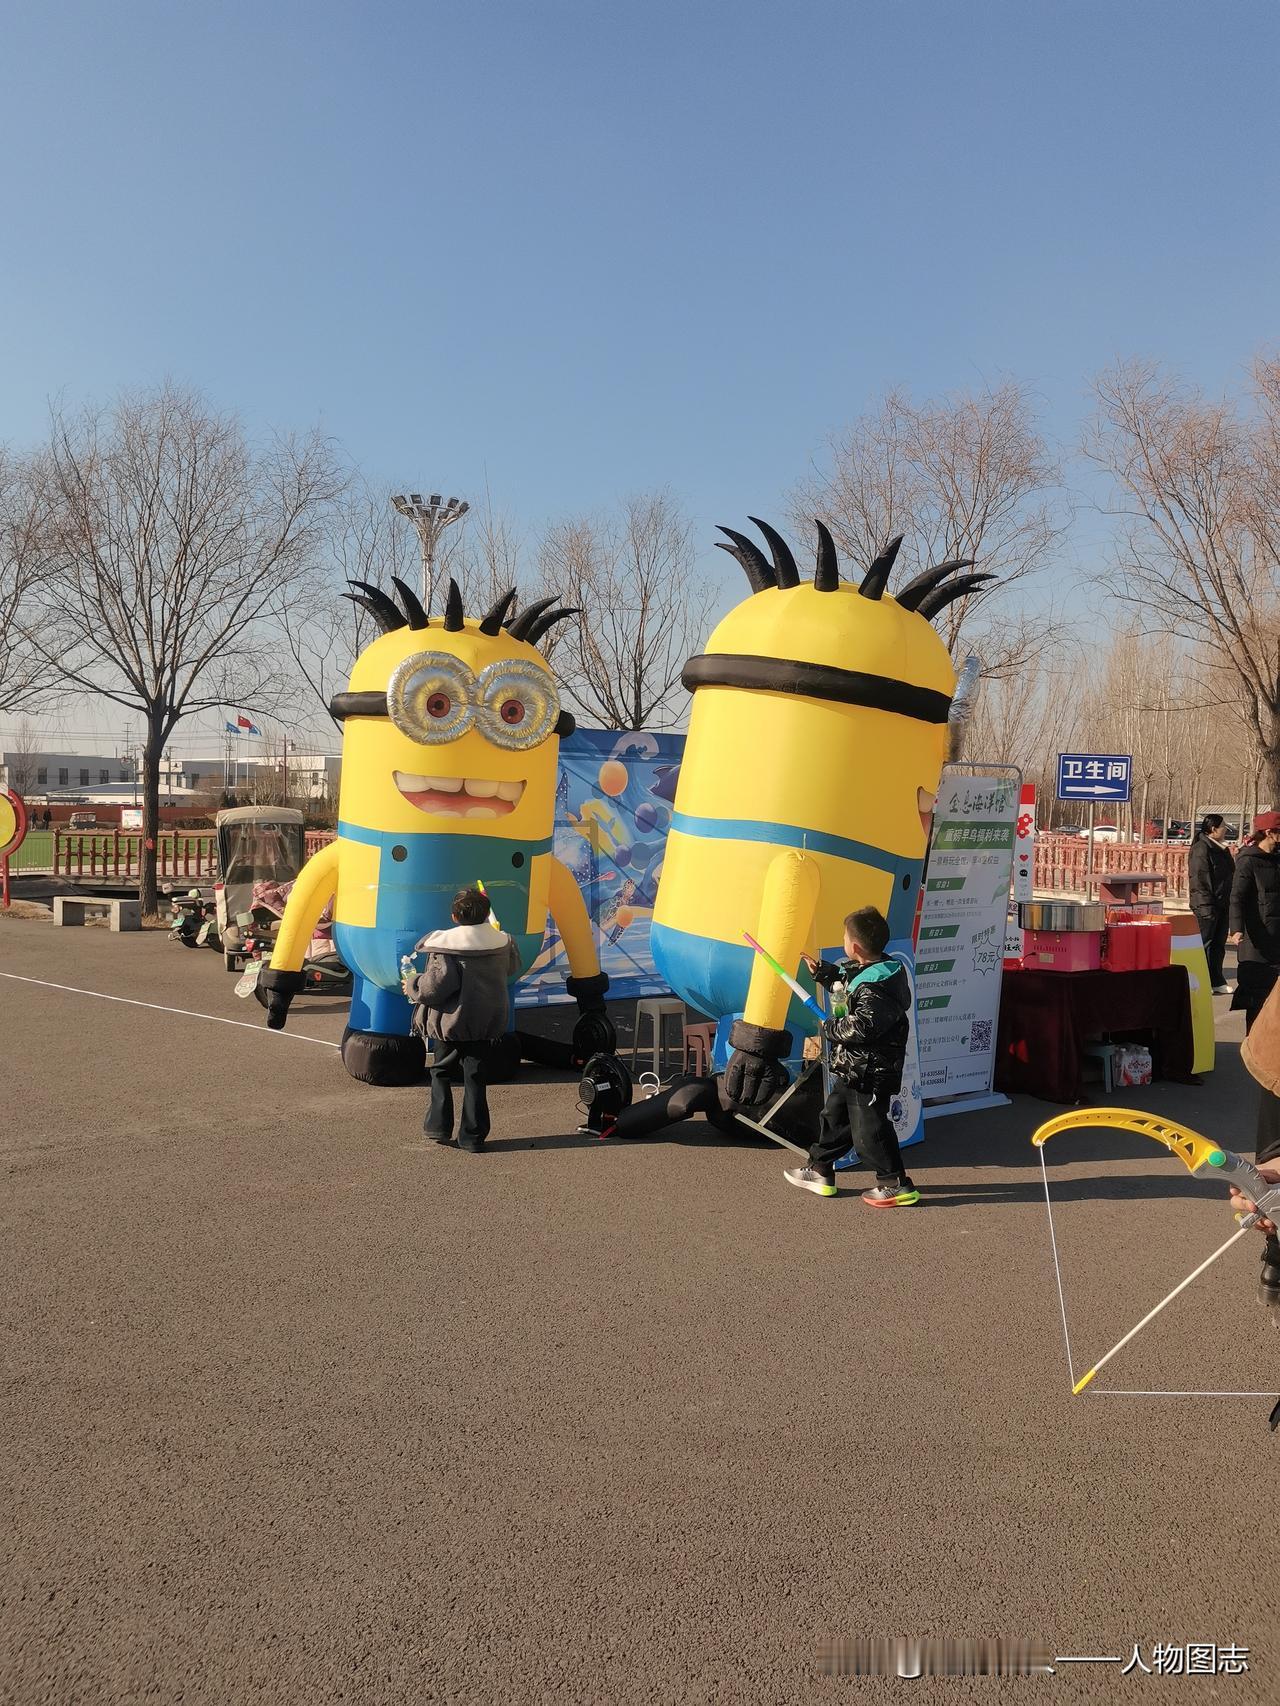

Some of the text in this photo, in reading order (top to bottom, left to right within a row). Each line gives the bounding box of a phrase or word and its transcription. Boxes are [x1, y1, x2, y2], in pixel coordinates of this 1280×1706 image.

[1063, 760, 1127, 781] 卫生间
[976, 951, 995, 964] 78元
